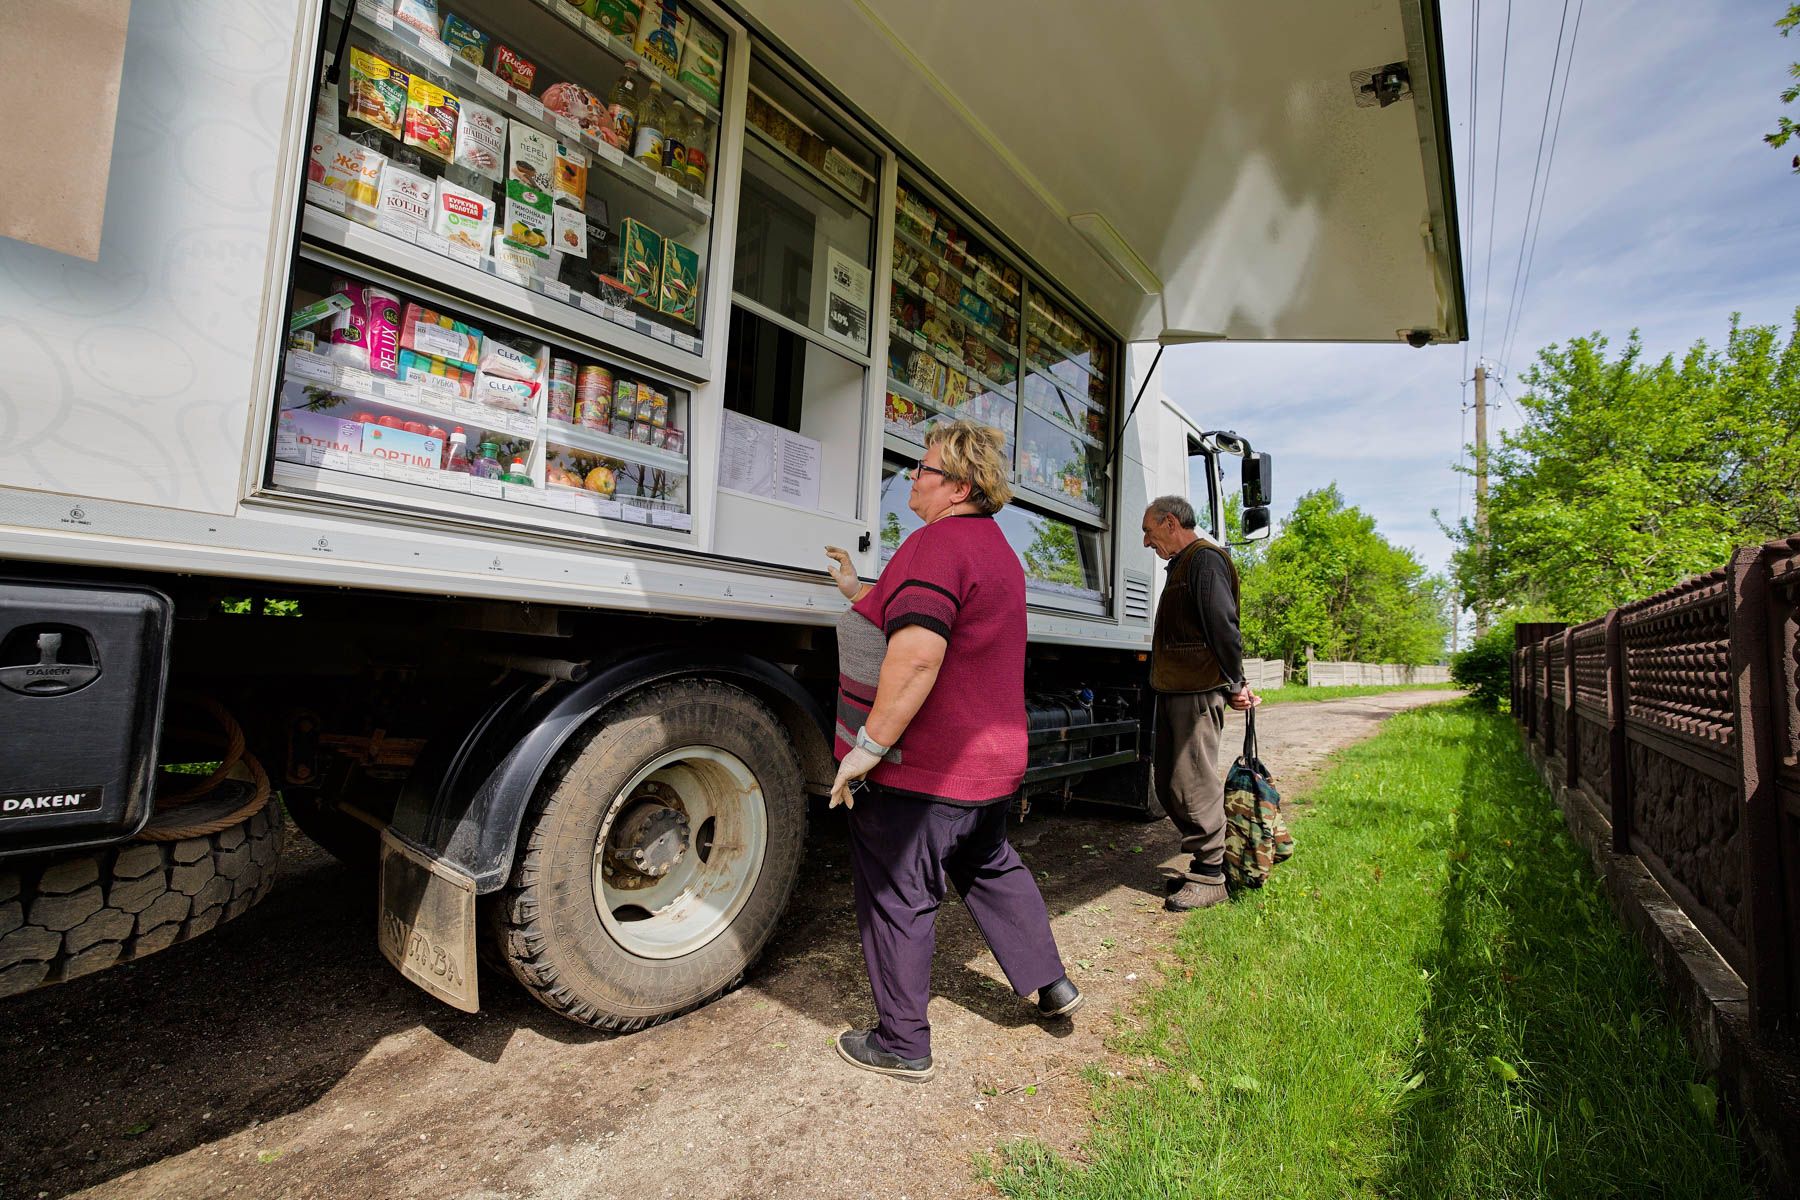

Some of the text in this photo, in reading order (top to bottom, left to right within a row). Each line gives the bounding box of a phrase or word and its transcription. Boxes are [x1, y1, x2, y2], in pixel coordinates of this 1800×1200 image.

[520, 142, 548, 161] ПЕРЕЦ
[336, 152, 379, 179] Желе
[512, 202, 546, 220] ЛИМОННАЯ
[514, 210, 543, 225] КИСЛОТА
[380, 325, 397, 371] RELUX
[25, 667, 71, 676] DAKEN
[3, 793, 81, 812] DAKEN
